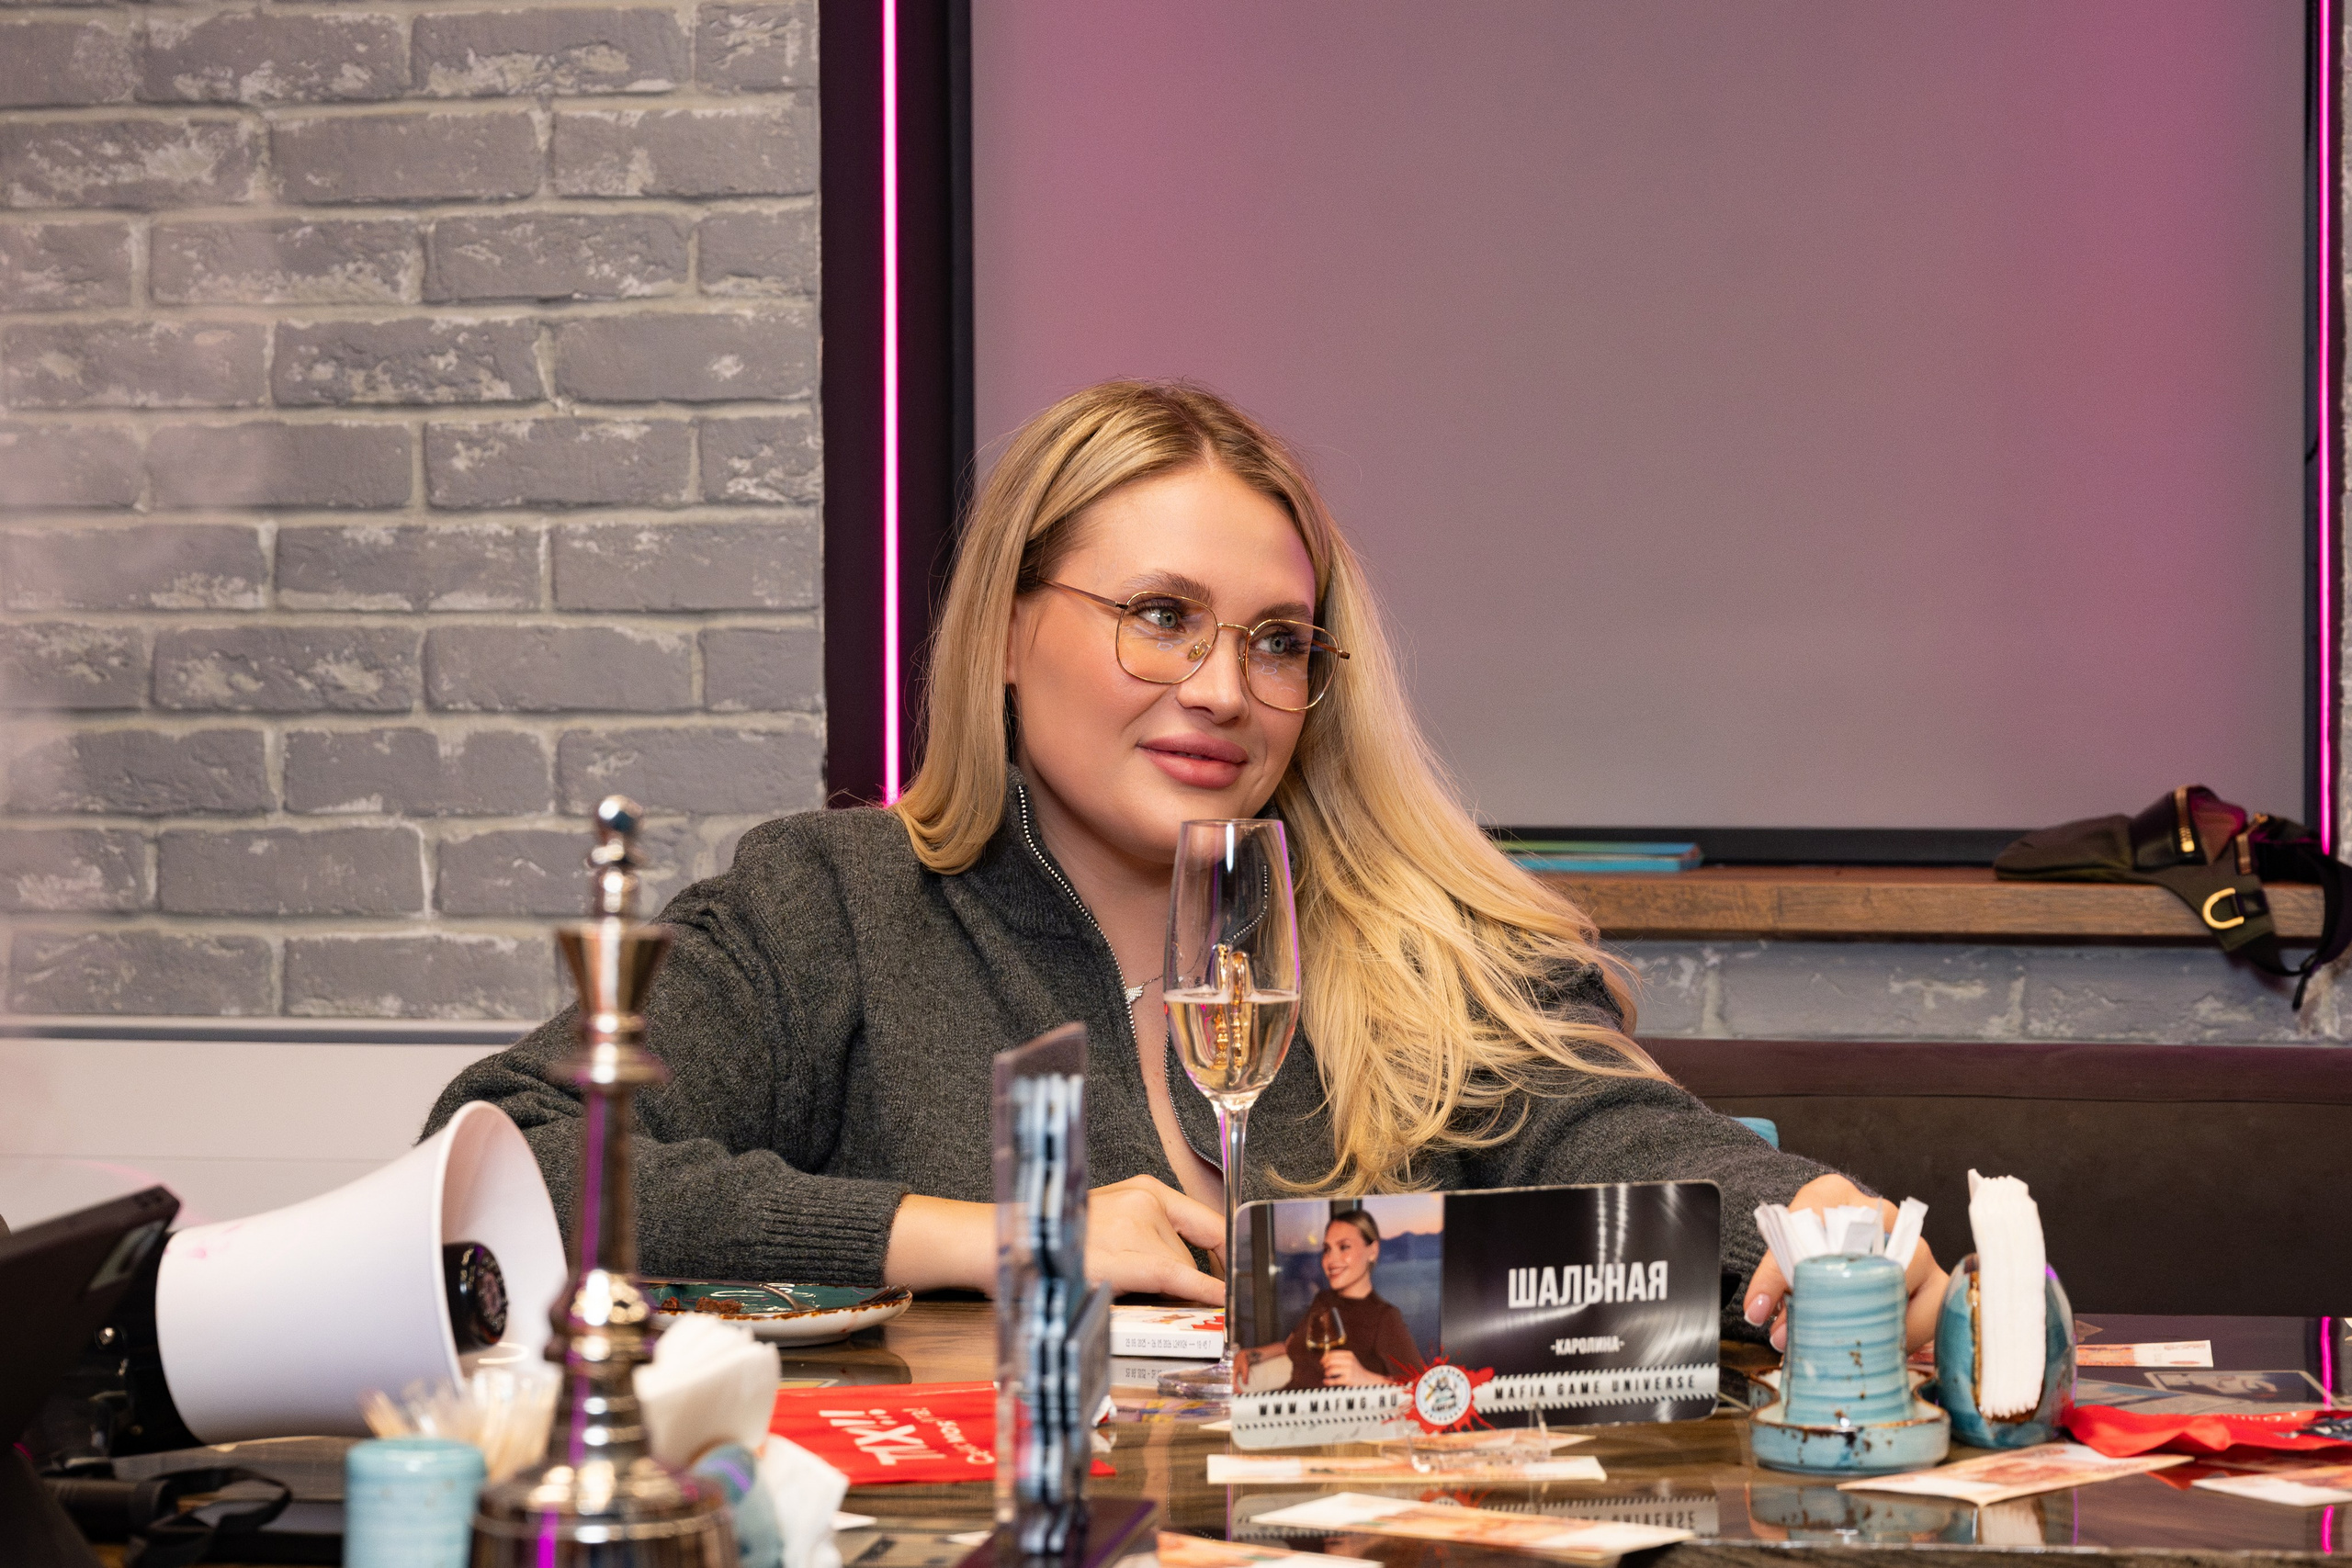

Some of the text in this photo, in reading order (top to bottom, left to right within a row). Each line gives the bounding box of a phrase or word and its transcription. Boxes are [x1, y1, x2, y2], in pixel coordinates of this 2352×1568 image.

[1508, 1259, 1668, 1309] ШАЛЬНАЯ
[1494, 1373, 1695, 1401] MAFIA GAME UNIVERSE
[1259, 1393, 1397, 1416] WWW.MAFWG.RU
